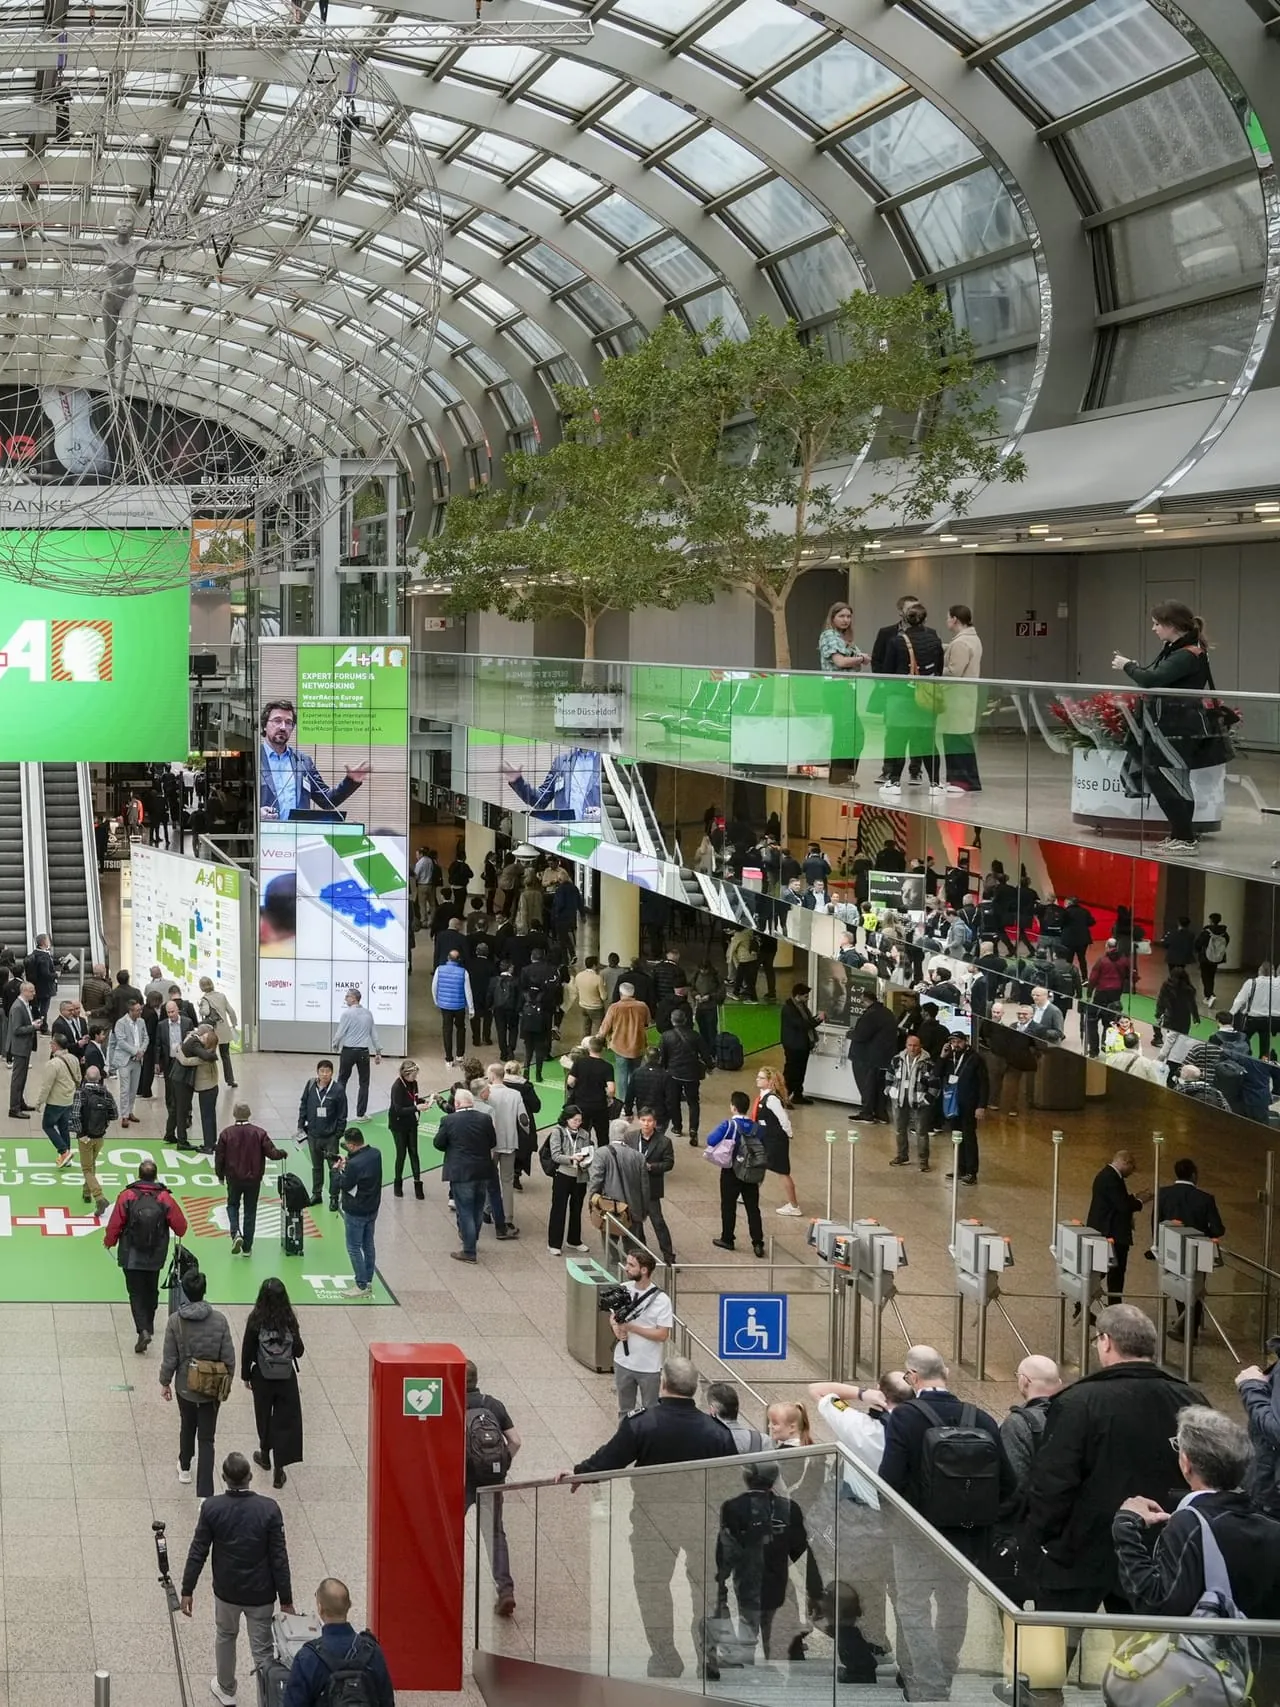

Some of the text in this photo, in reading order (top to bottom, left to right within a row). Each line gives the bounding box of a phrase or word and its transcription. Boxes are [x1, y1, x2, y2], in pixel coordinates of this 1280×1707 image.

[335, 646, 385, 667] A+A
[302, 672, 332, 680] EXPERT
[334, 672, 367, 680] FORUMS
[302, 682, 356, 690] NETWORKING
[850, 1006, 866, 1014] 202
